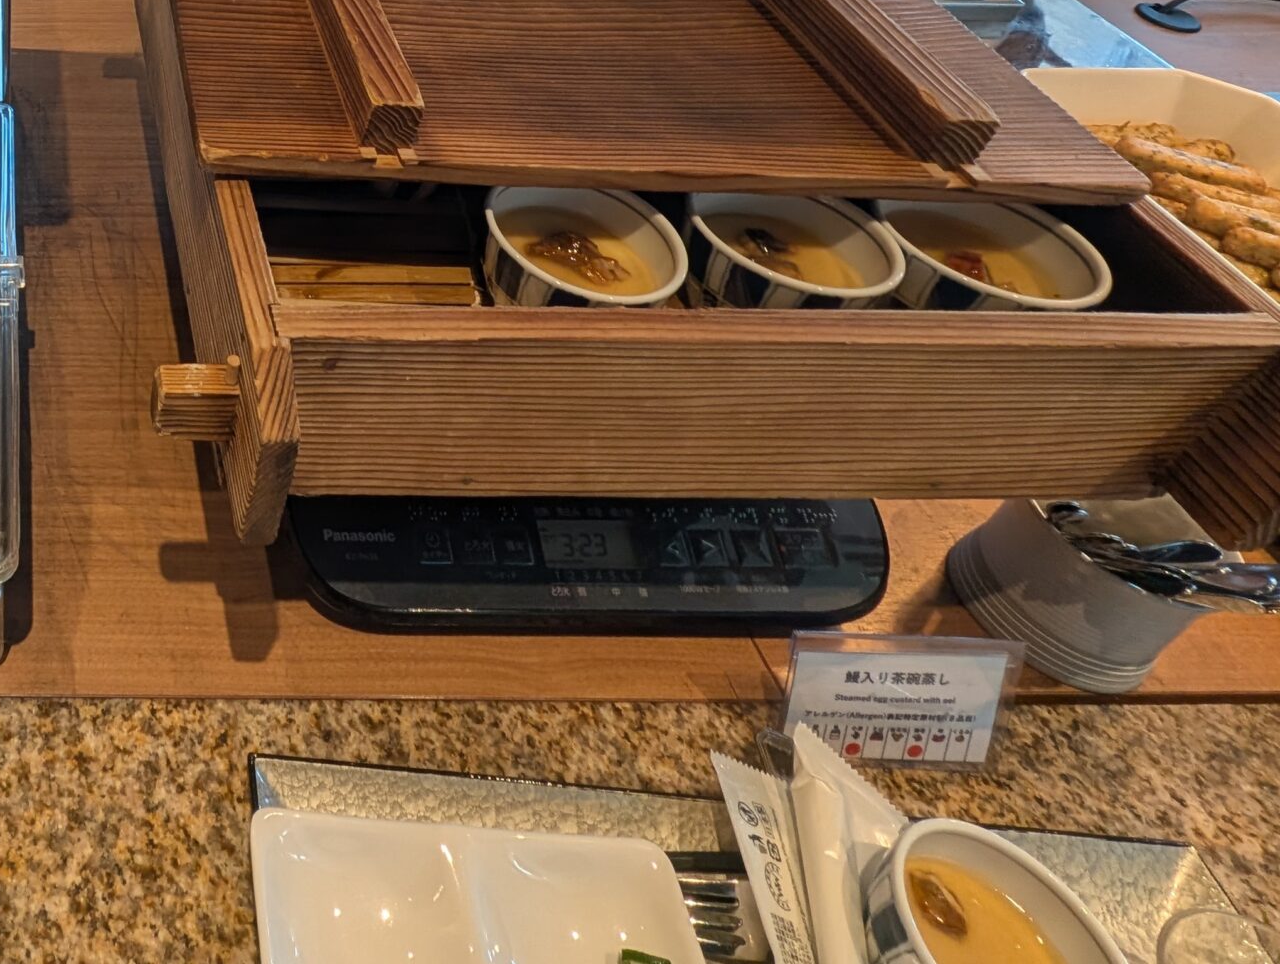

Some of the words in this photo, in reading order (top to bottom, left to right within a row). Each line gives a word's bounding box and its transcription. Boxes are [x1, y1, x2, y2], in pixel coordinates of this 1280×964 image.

[323, 529, 396, 543] Panasonic
[845, 671, 949, 686] 鰻入り茶碗蒸し
[834, 694, 871, 702] Steamed
[873, 696, 888, 705] egg
[889, 695, 921, 704] custard
[923, 696, 941, 704] with
